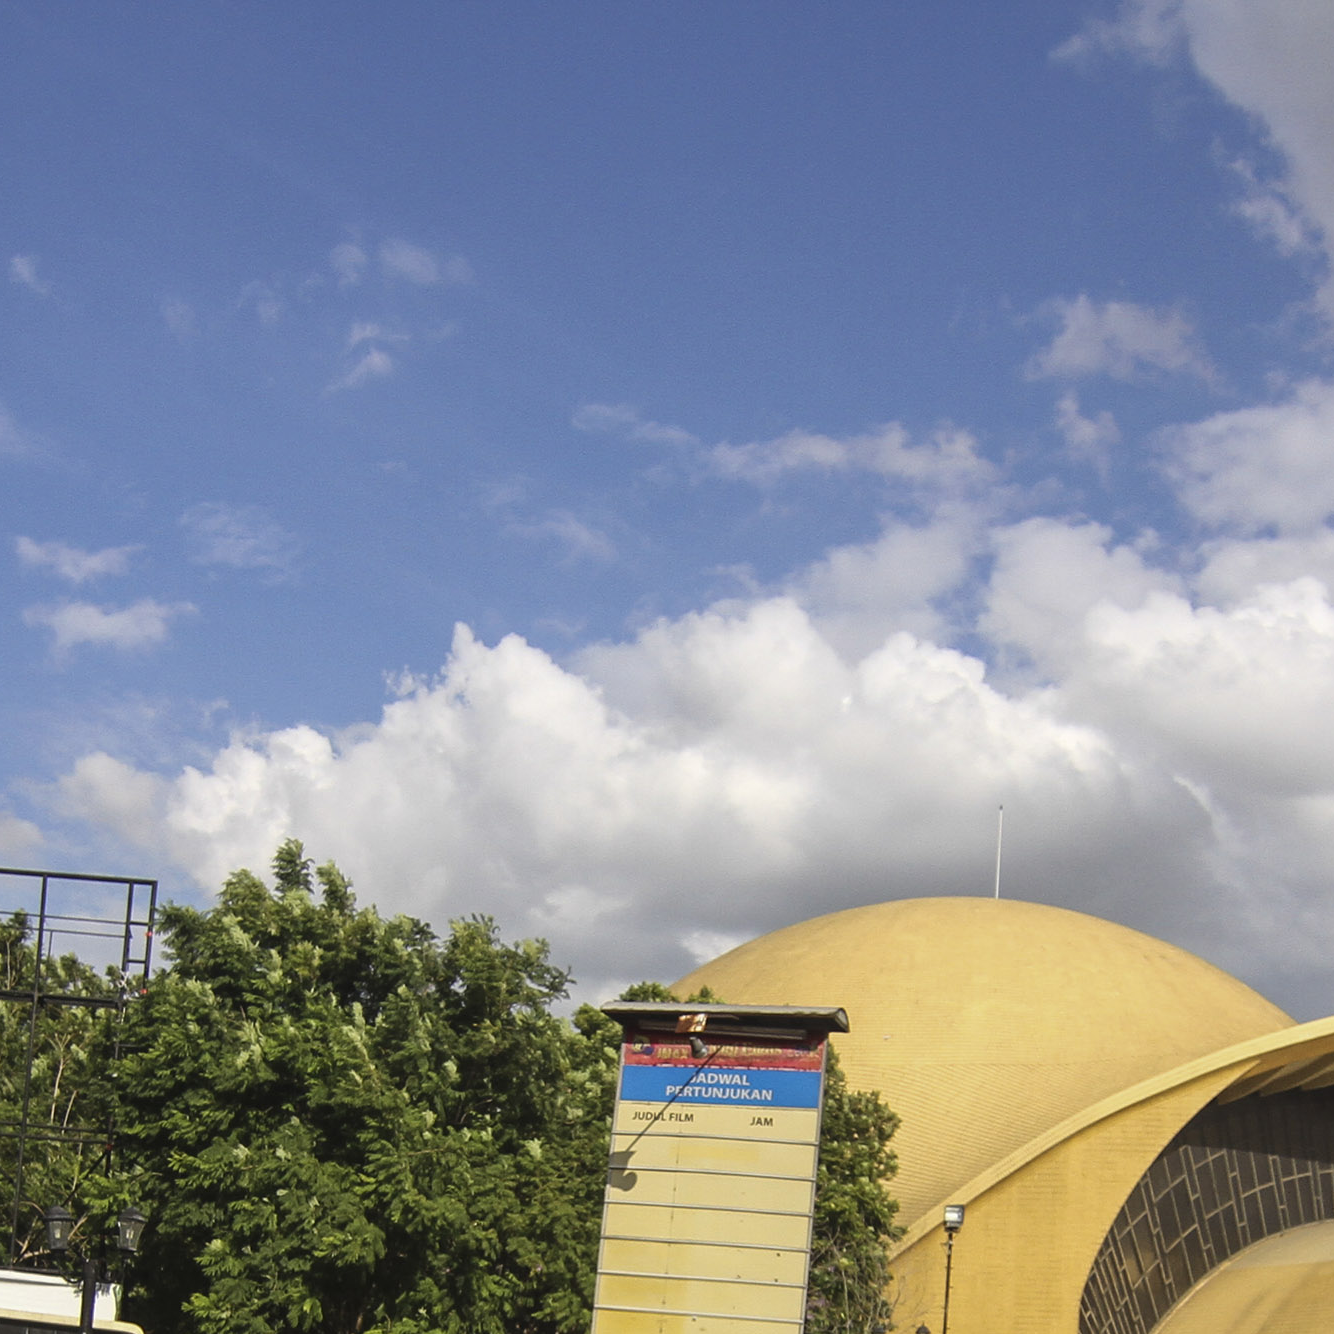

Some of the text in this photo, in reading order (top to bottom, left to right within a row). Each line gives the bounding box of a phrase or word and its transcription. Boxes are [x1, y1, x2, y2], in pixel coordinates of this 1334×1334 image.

[689, 1072, 750, 1086] JADWAL
[665, 1085, 773, 1101] PERTUNJUKAN
[632, 1111, 694, 1122] JUDUL FILM
[749, 1116, 774, 1126] JAM
